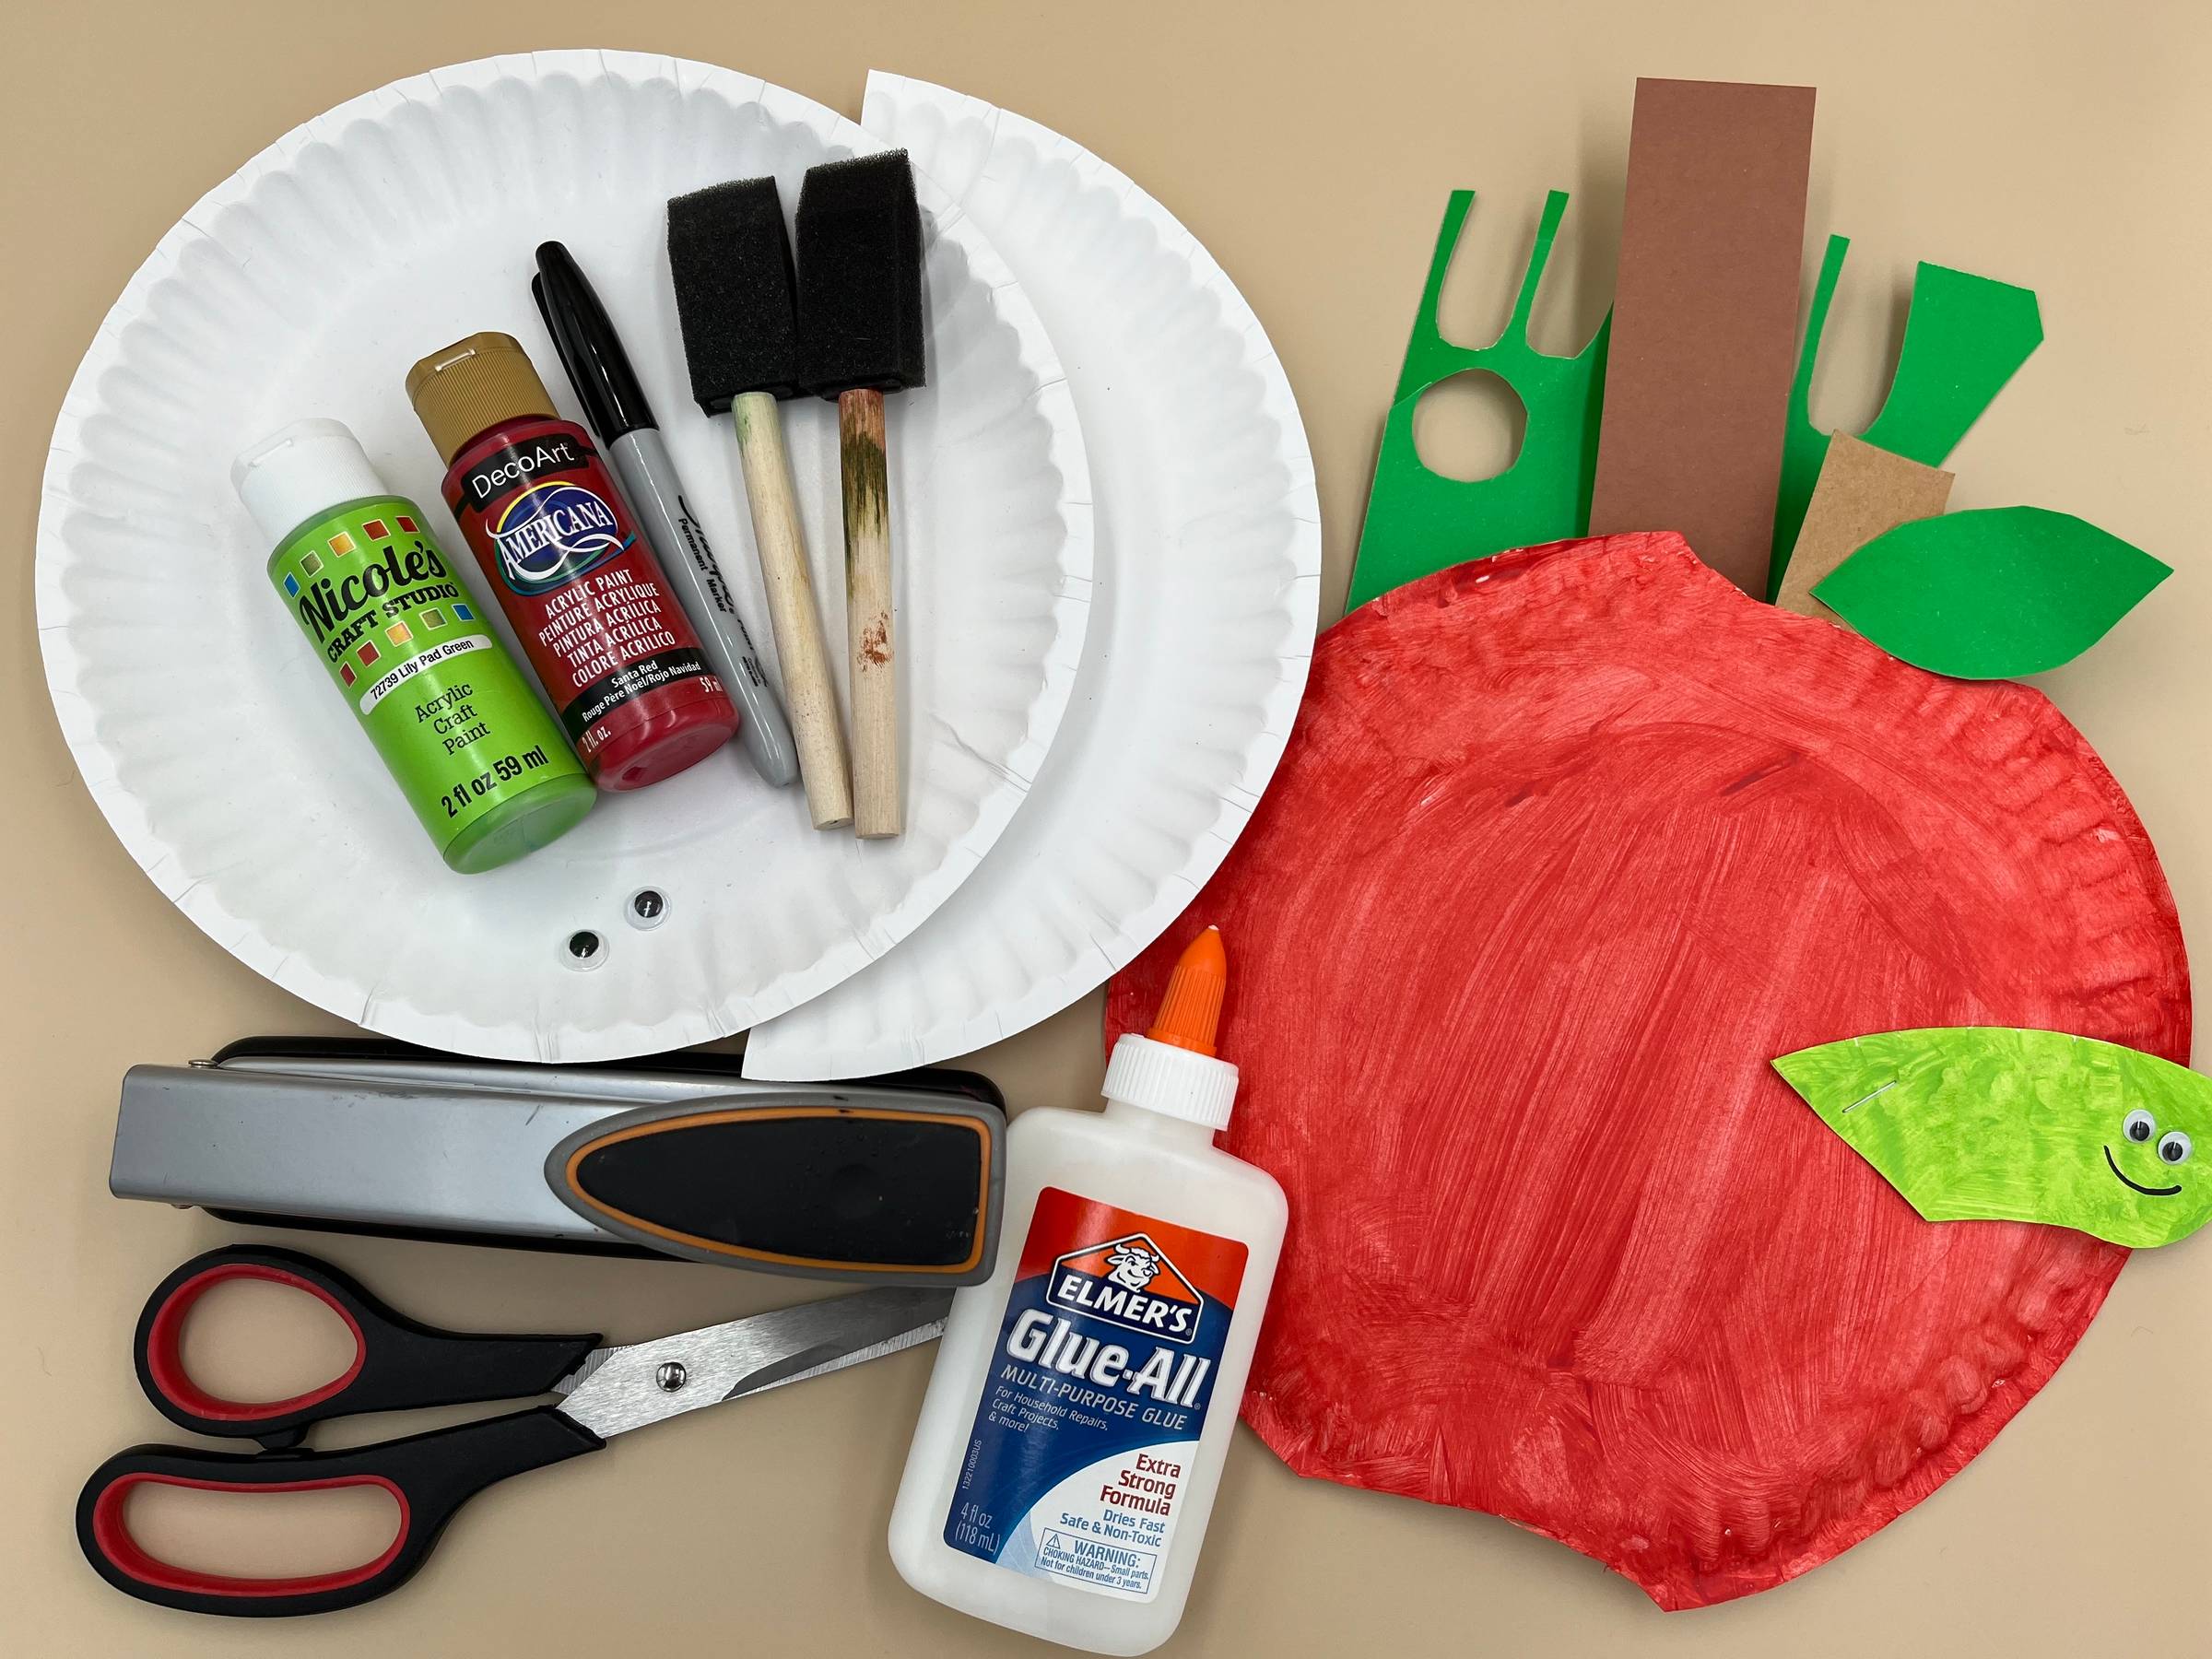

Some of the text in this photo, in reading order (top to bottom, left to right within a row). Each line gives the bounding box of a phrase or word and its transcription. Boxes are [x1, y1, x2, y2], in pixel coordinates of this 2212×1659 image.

[472, 442, 574, 499] DecoArt
[496, 500, 614, 580] AMERICANA
[678, 518, 709, 571] Permanent
[299, 540, 447, 643] Nicole's
[545, 569, 633, 619] ACRYLIC PAINT
[706, 579, 727, 613] Marker
[327, 582, 459, 663] CRAFT STUDIO
[538, 582, 660, 647] PEINTURE ACRYLIQUE
[553, 599, 662, 657] PINTURA ACRÍLICA
[567, 617, 663, 668] TINTA ACRÍLICA
[571, 630, 676, 688] COLORE ACRILICO
[370, 639, 475, 700] 72739 Lily Pad Green
[611, 660, 658, 688] Santa Red
[700, 676, 713, 693] 59
[415, 683, 473, 723] Acrylic
[582, 661, 701, 723] Rouge Père Noël/Rojo Navidad
[433, 704, 478, 735] Craft
[441, 722, 490, 755] Paint
[582, 725, 612, 753] 2 fl. oz.
[441, 745, 549, 818] 2 fl oz 59 ml
[1057, 1274, 1192, 1334] ELMER'S
[1006, 1308, 1211, 1408] Glue-All
[992, 1398, 1059, 1431] Craft Projects,
[995, 1385, 1109, 1431] For Household Repairs,
[1000, 1364, 1188, 1430] MULTI-PURPOSE GLUE
[988, 1411, 1030, 1433] & more!
[961, 1439, 982, 1489] 132210003US
[1135, 1453, 1182, 1478] Extra
[1100, 1485, 1171, 1516] Formula
[1118, 1469, 1176, 1500] Strong
[960, 1502, 993, 1529] 4 fl oz
[1060, 1512, 1162, 1547] Safe & Non-Toxic
[1103, 1509, 1166, 1534] Dries Fast
[955, 1520, 1000, 1555] (118 mL)
[1074, 1540, 1141, 1568] WARNING:
[1041, 1557, 1142, 1590] Not for children under 3 years.
[1043, 1547, 1075, 1563] CHOKING
[1131, 1569, 1149, 1581] parts.
